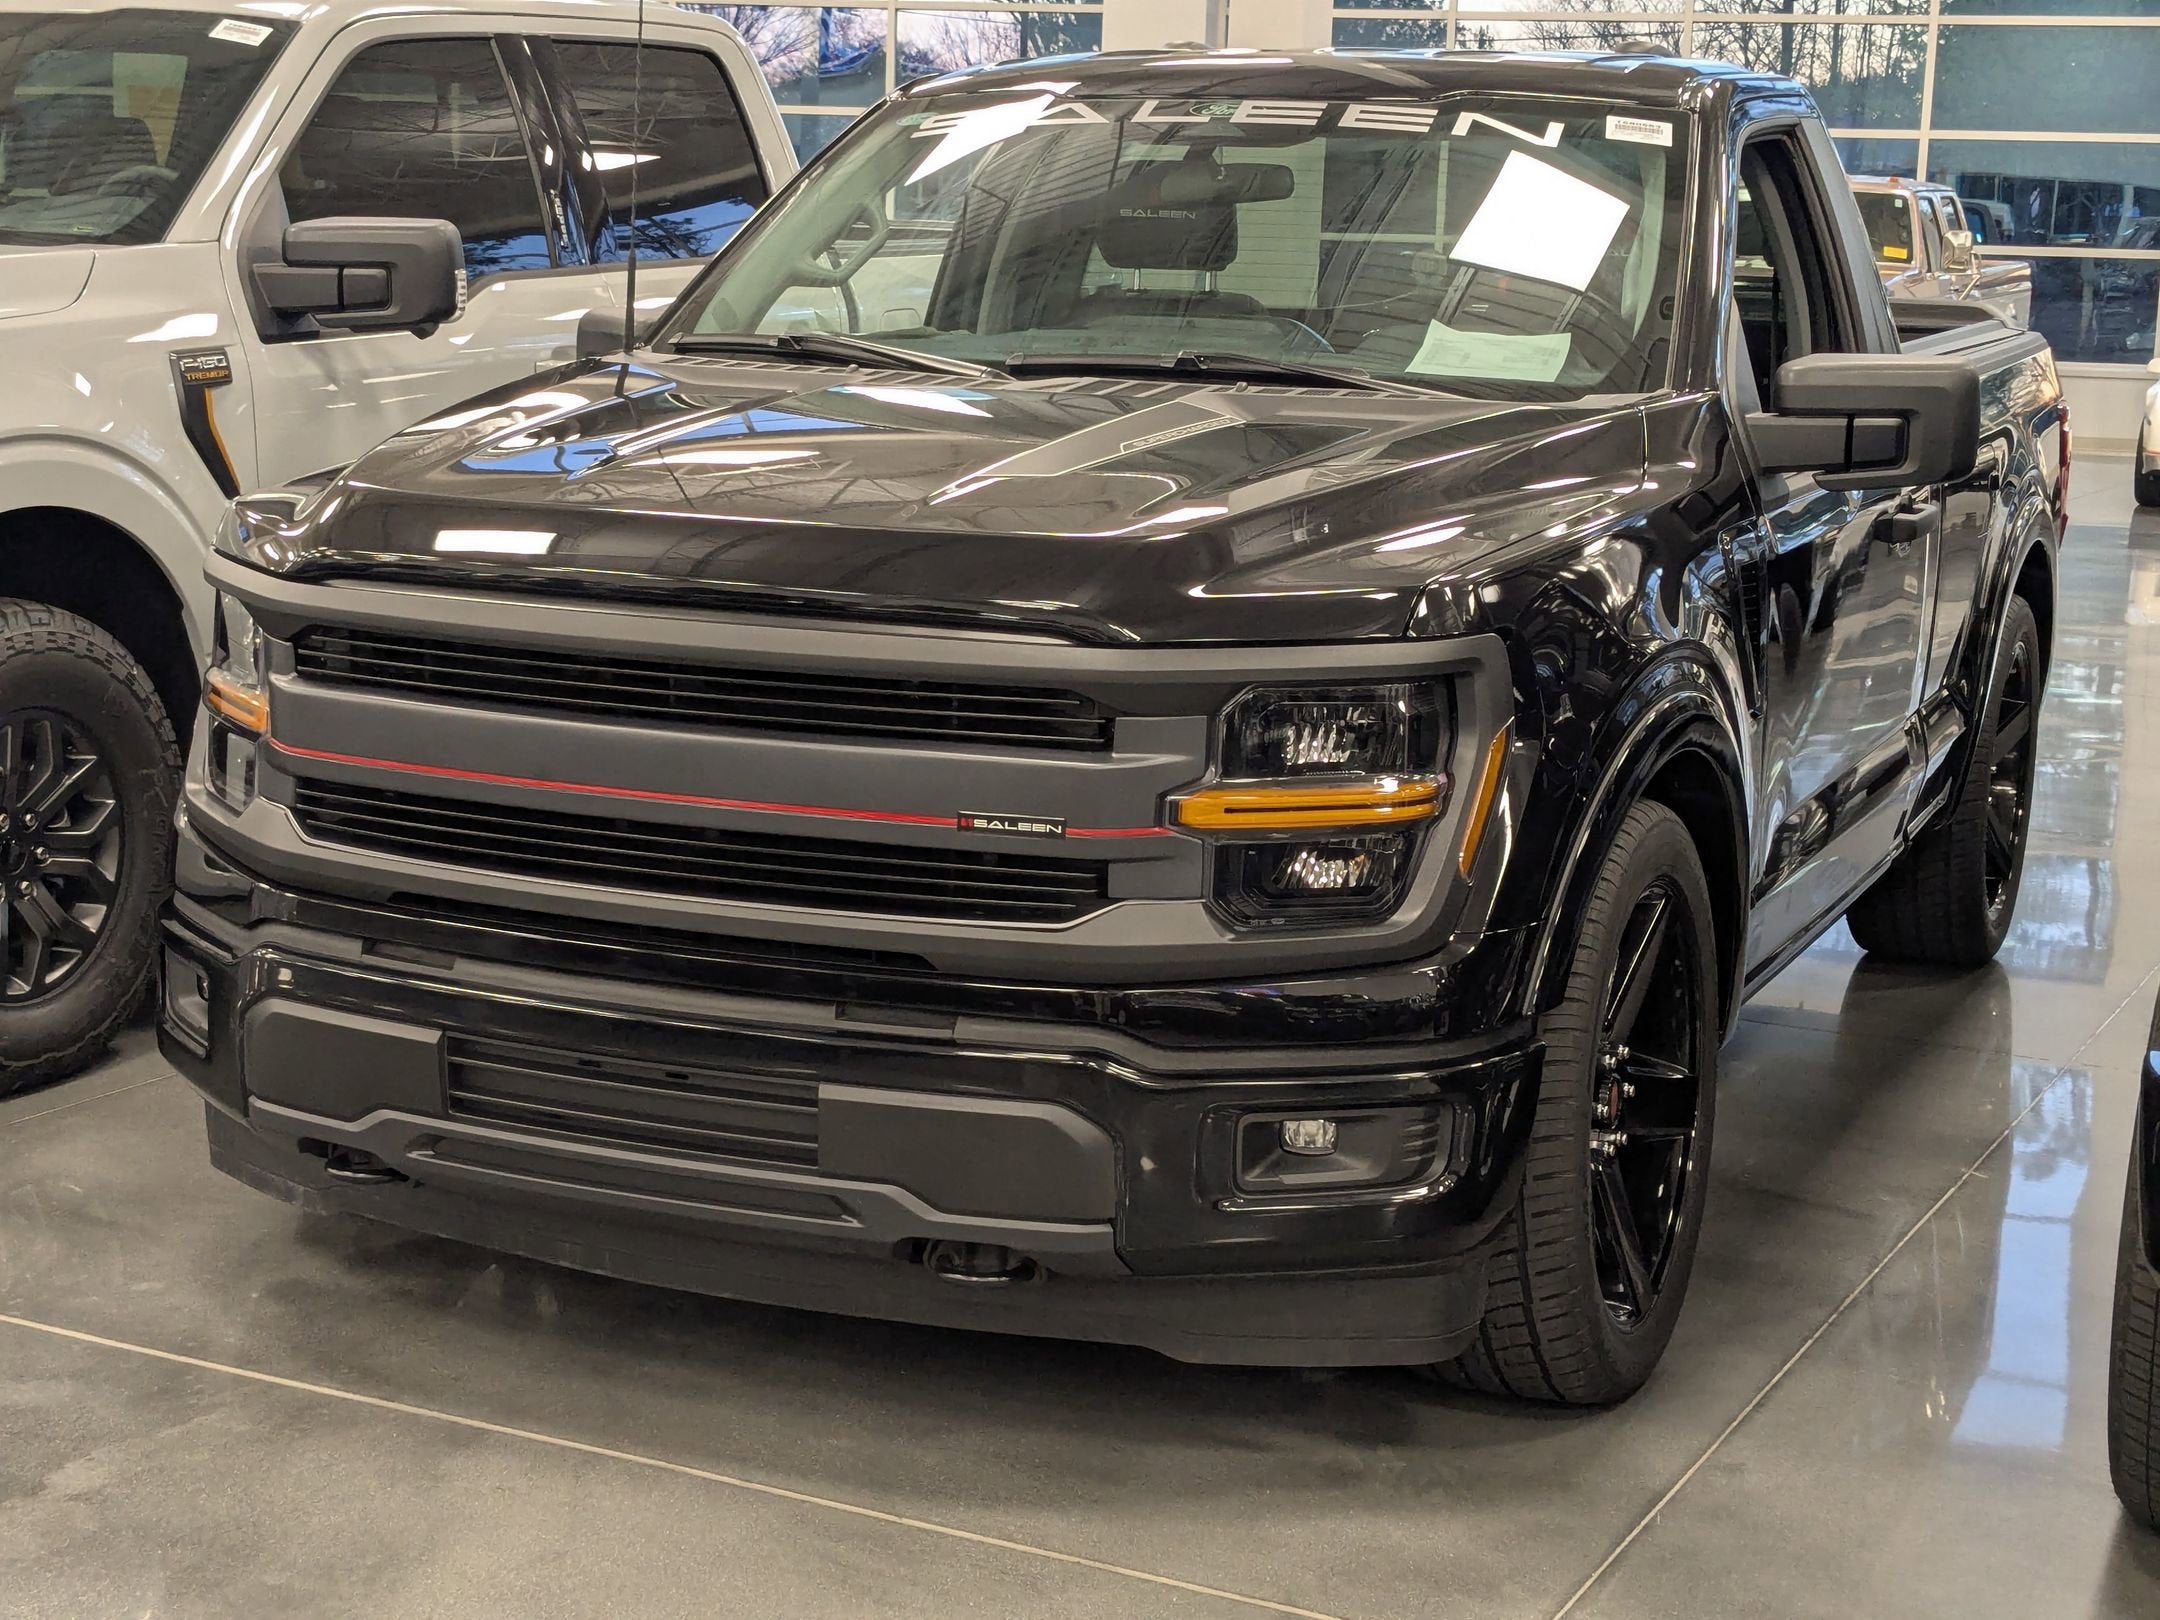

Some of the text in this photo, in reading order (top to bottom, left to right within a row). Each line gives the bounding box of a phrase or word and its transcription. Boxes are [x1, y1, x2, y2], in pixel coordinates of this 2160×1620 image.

[1120, 208, 1196, 219] SALEEN
[186, 369, 229, 381] TREMOR
[1132, 419, 1231, 447] SUPERCHARGED
[973, 818, 1062, 833] SALEEN
